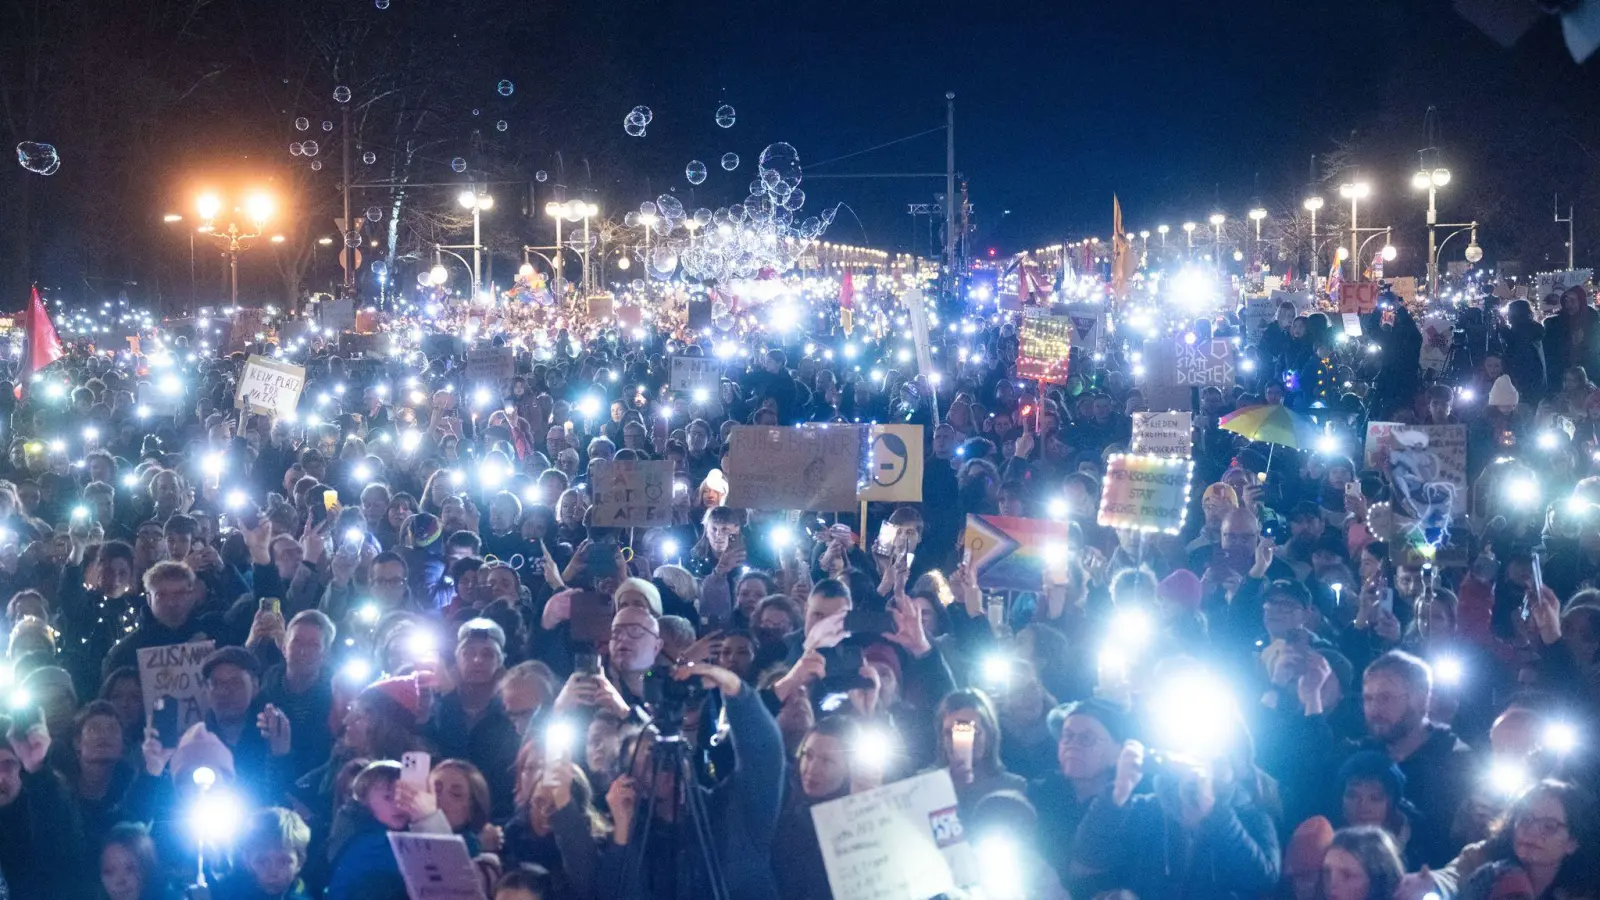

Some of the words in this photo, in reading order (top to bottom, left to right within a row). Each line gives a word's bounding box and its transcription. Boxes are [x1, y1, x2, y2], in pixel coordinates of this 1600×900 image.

[1177, 356, 1208, 371] STATT
[249, 367, 273, 383] KEIN
[275, 376, 300, 392] PLATZ
[1177, 361, 1234, 385] DÜSTER
[249, 388, 277, 406] NAZIS
[1145, 420, 1178, 428] FRIEDEN
[1178, 436, 1185, 445] &
[1137, 445, 1187, 454] DEMOKRATIE
